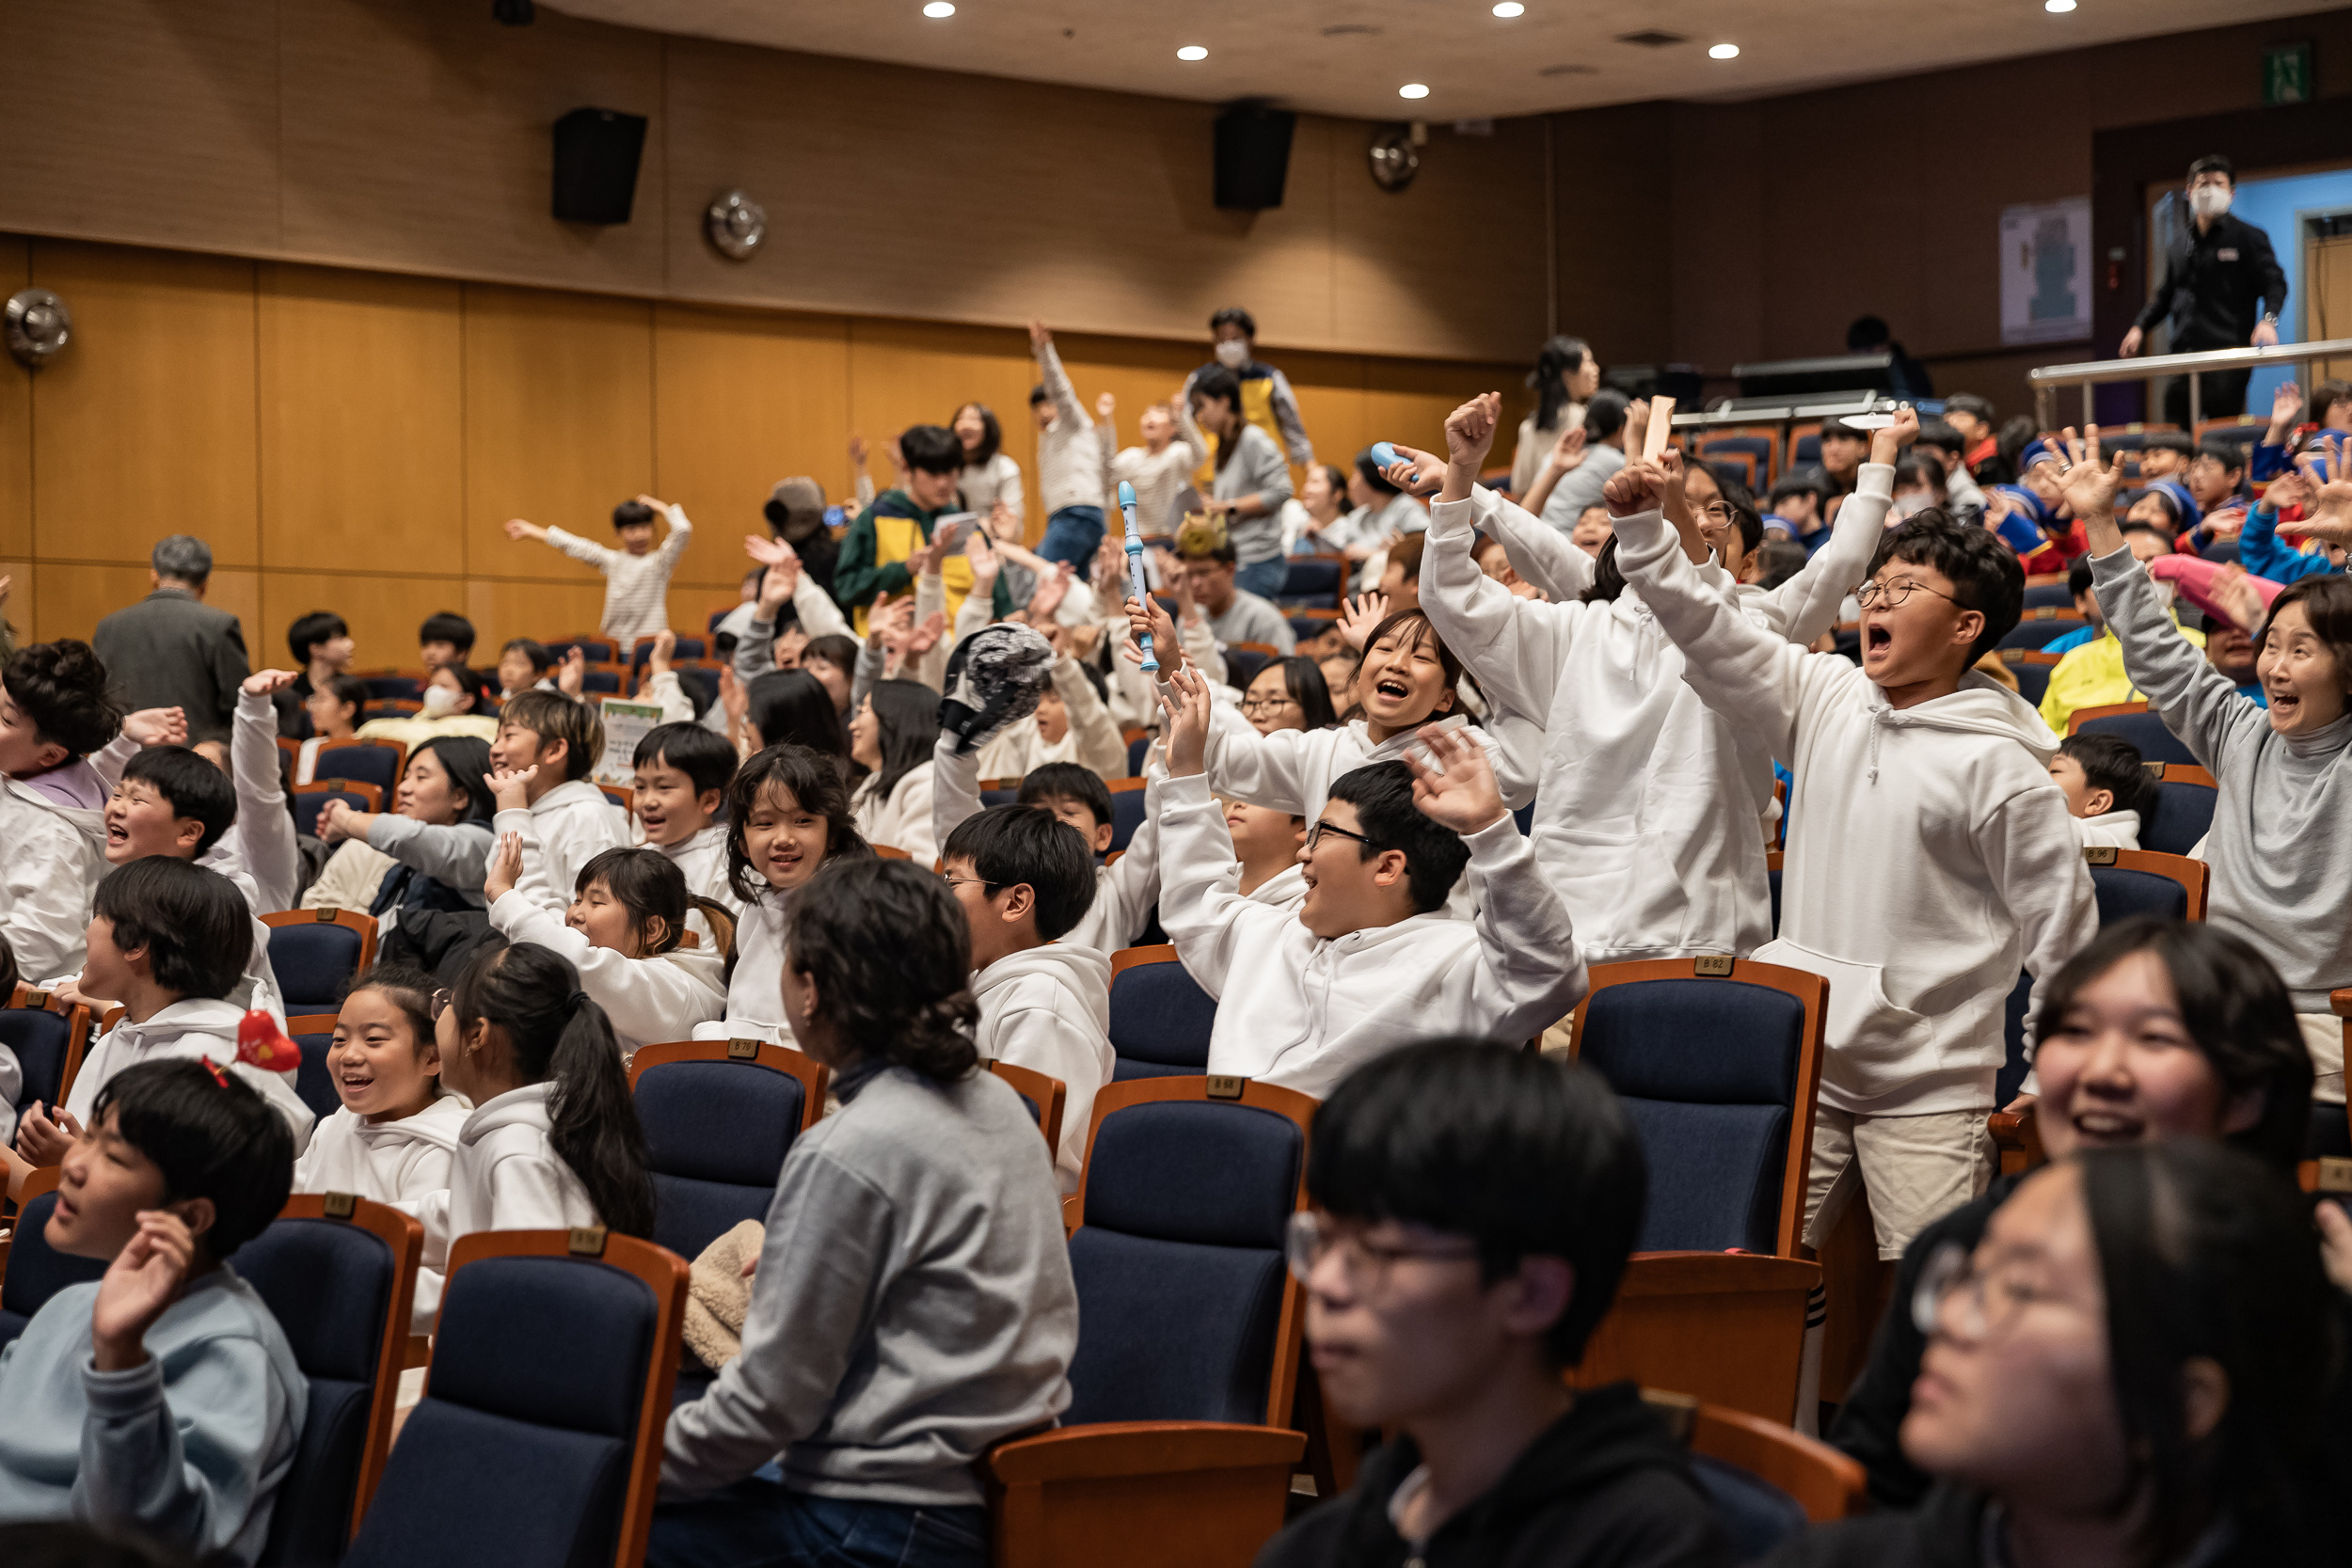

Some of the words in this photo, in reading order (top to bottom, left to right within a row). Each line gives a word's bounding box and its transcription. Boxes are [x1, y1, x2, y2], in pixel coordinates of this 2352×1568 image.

[2089, 849, 2094, 858] B
[2097, 849, 2108, 858] 96
[1704, 958, 1709, 968] B
[1712, 958, 1724, 968] 82
[735, 1041, 740, 1050] B
[742, 1041, 752, 1051] 70
